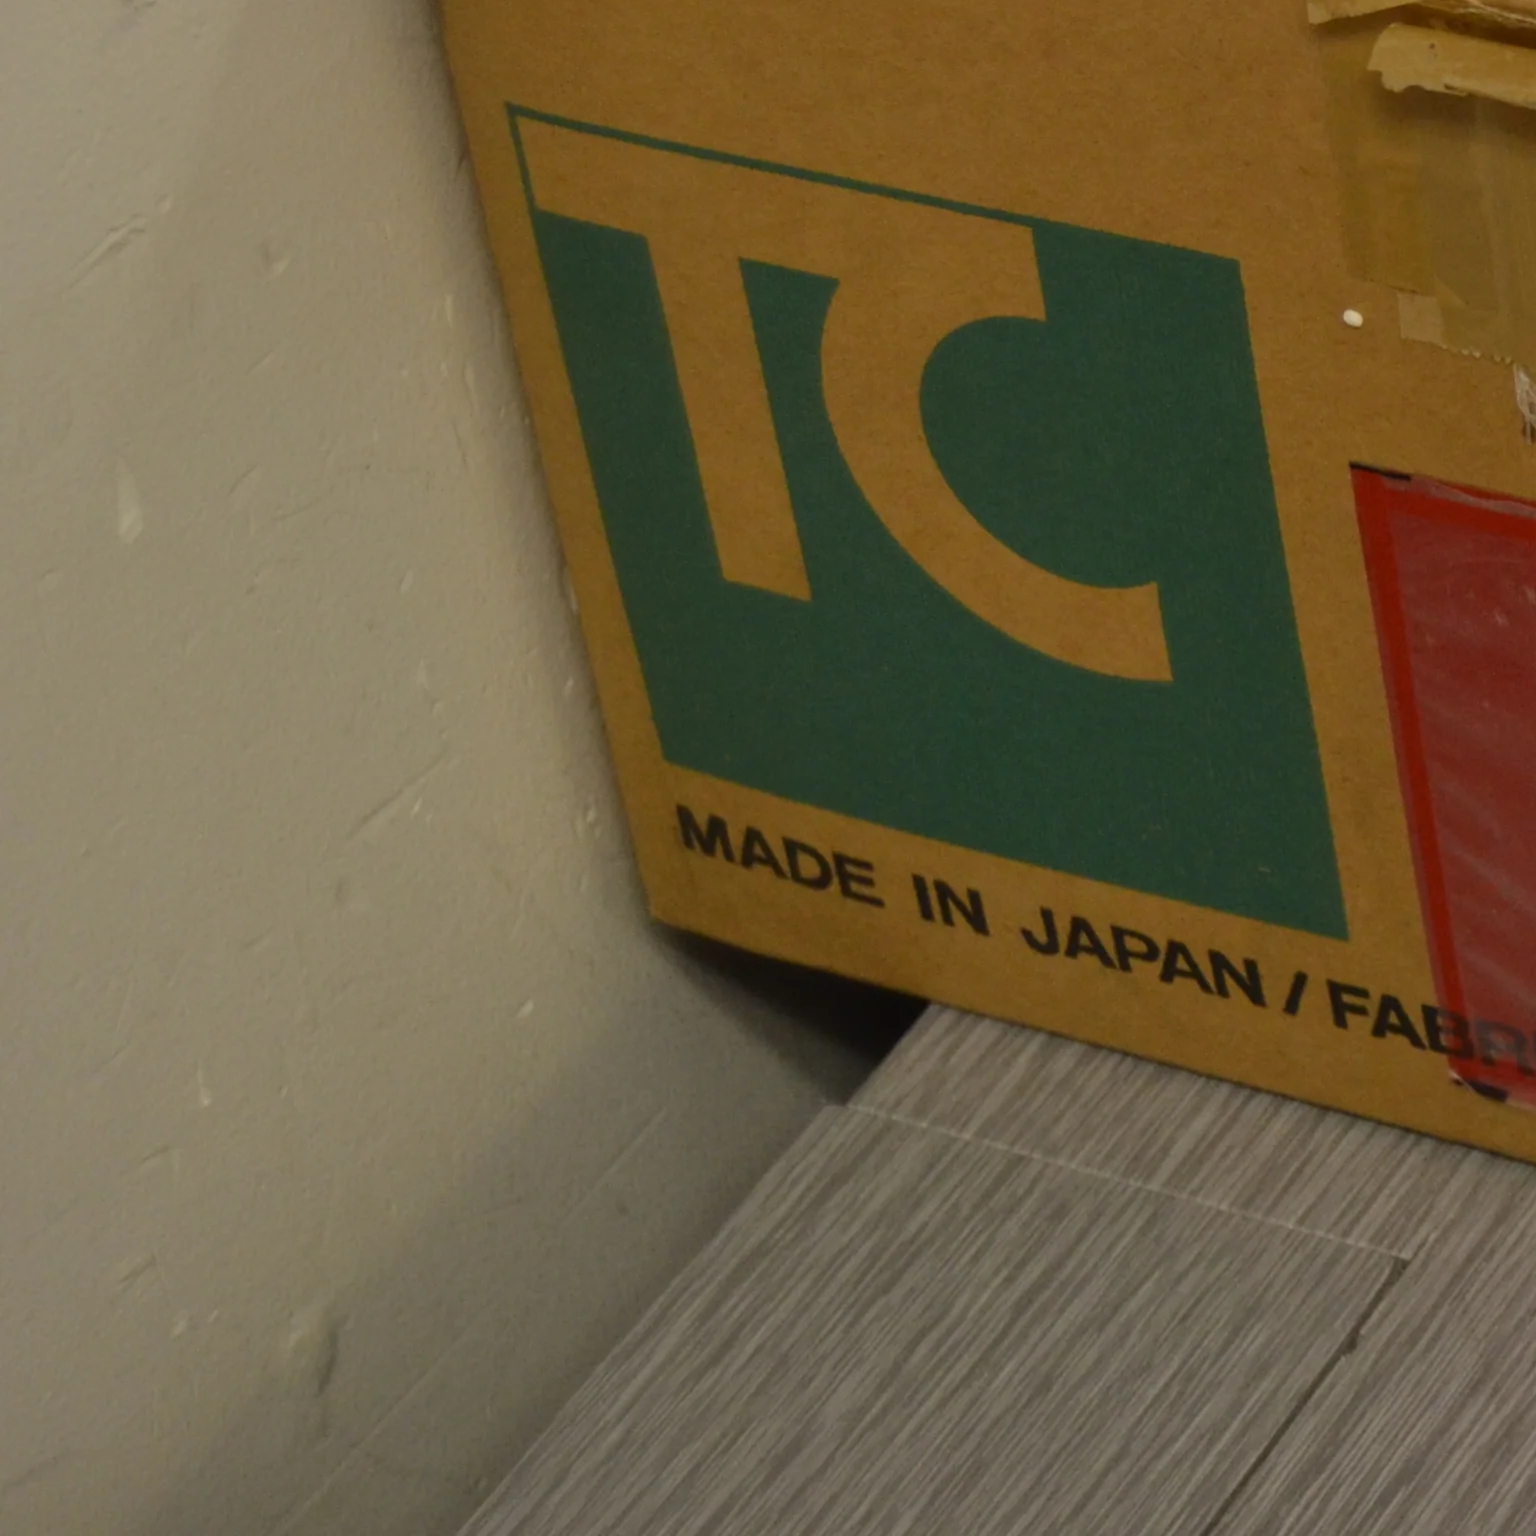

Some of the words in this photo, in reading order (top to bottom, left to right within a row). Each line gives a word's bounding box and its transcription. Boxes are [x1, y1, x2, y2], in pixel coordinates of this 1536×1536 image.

[508, 104, 1175, 684] TC
[675, 804, 885, 908] MADE
[911, 873, 990, 937] IN
[1021, 907, 1266, 1007] JAPAN
